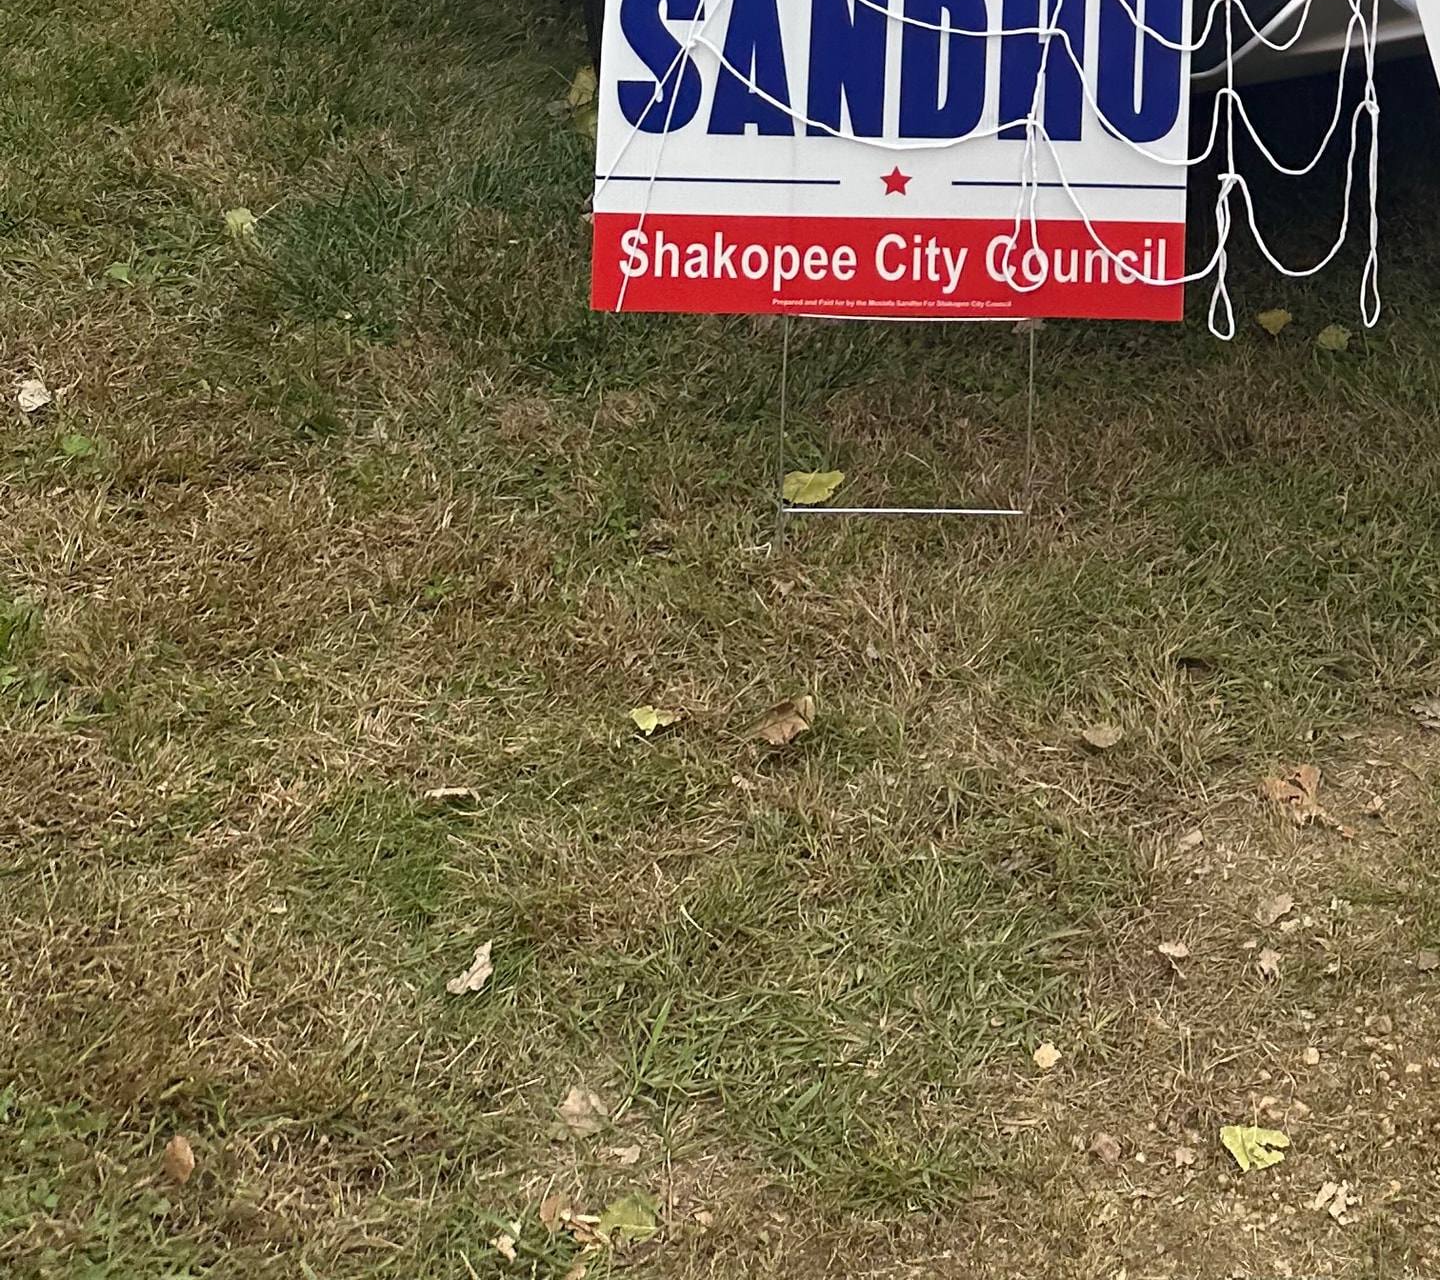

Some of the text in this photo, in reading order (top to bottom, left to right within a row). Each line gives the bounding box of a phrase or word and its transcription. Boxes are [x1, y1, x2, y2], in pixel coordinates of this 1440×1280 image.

[619, 229, 1168, 294] Shakopee City Council
